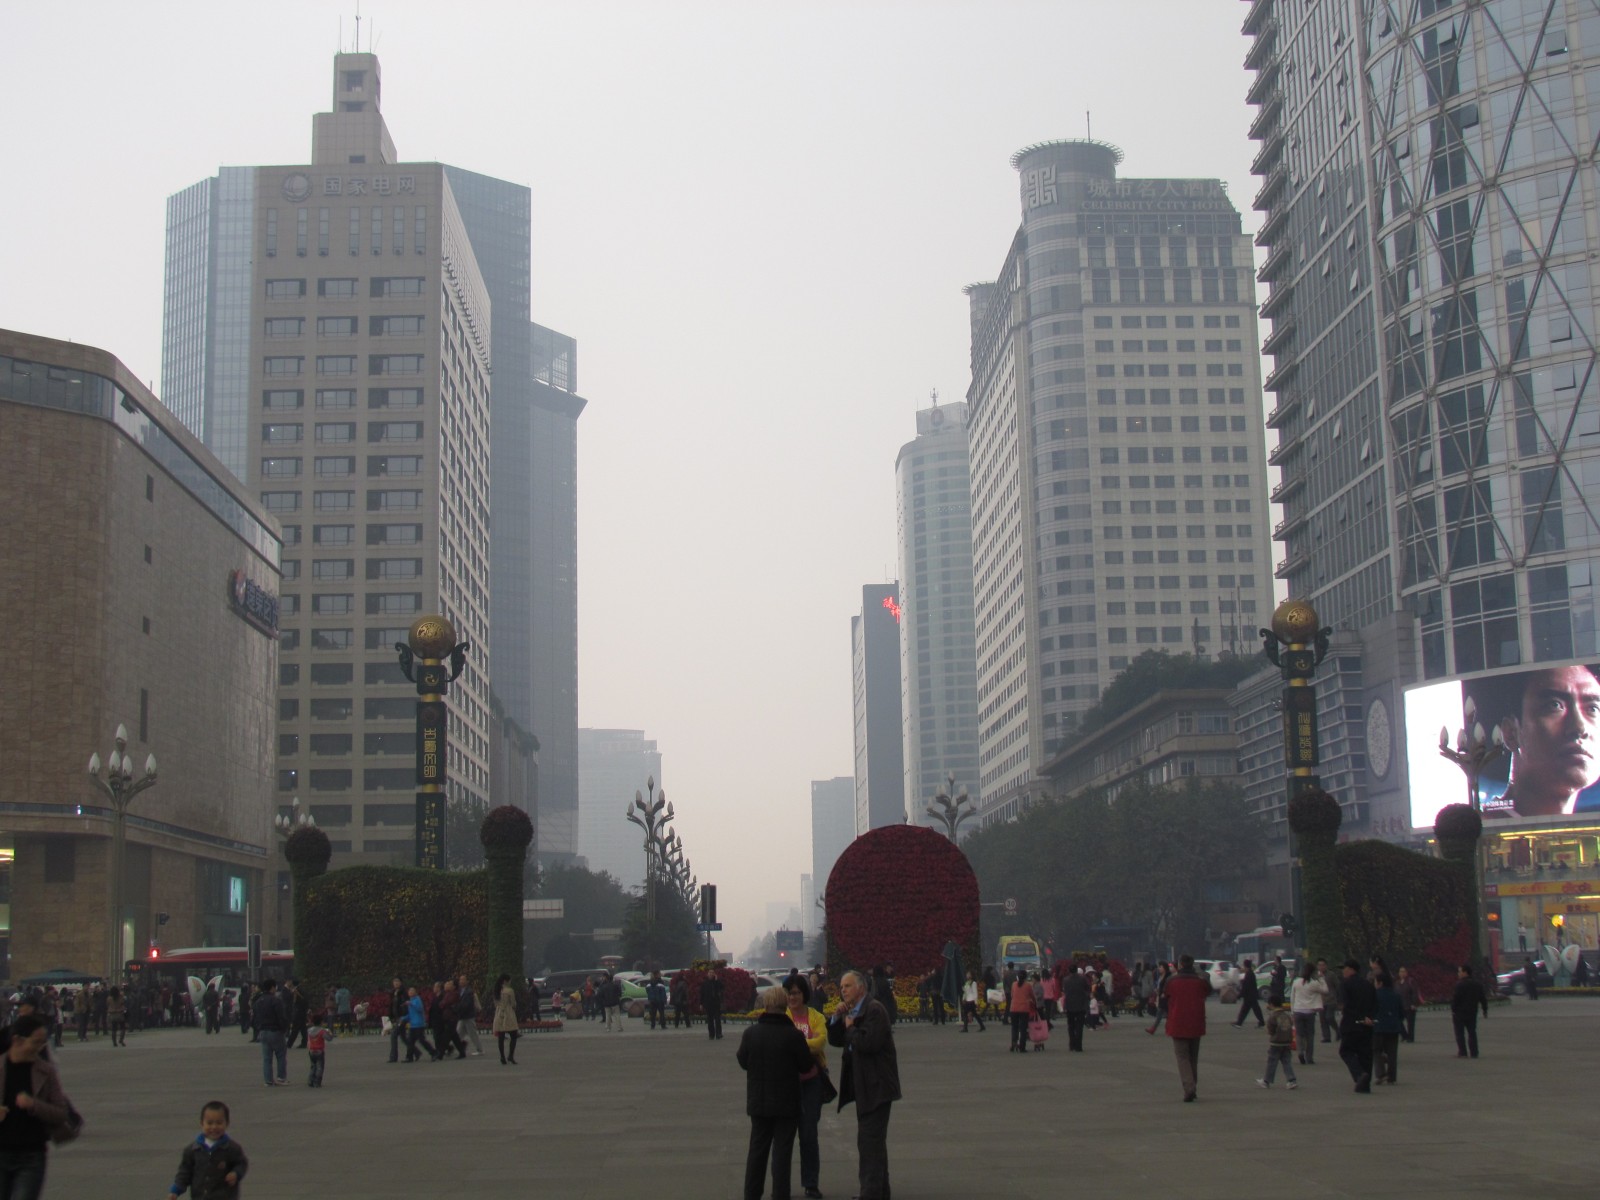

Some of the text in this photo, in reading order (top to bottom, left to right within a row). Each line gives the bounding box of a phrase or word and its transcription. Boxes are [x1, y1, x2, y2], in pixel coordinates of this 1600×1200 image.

[323, 175, 417, 196] 国家电网
[1081, 200, 1152, 211] CELEBRITY
[1156, 200, 1190, 211] CITY
